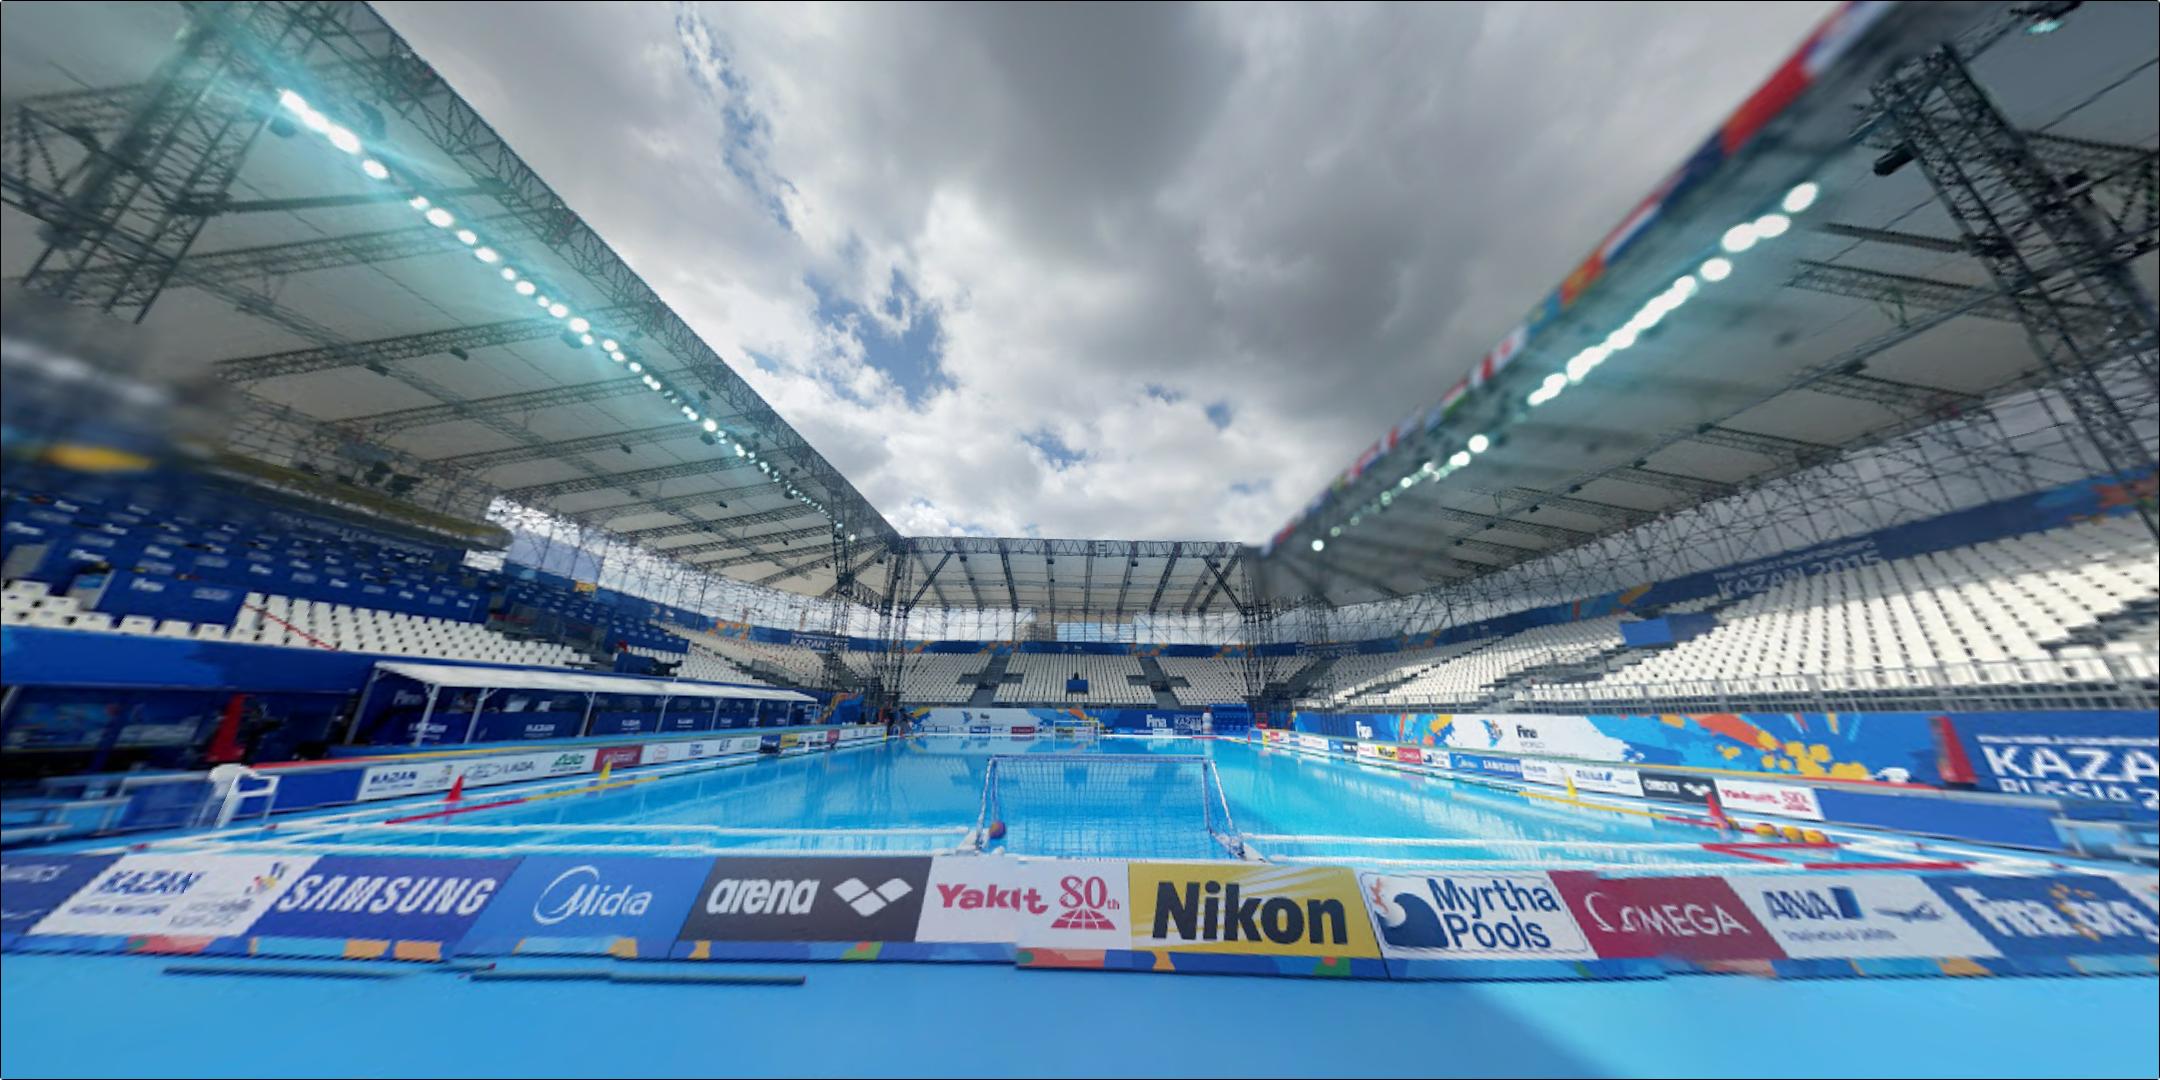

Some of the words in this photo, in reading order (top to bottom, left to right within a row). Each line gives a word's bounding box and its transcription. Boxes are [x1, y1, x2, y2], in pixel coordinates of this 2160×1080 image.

[1979, 744, 2159, 783] KAZA
[277, 875, 497, 916] SAMSUNG
[706, 878, 820, 916] arena
[1152, 880, 1348, 945] Nikon
[1428, 878, 1561, 919] Myrtha
[1761, 889, 1839, 921] ANA
[1443, 912, 1552, 950] Pools
